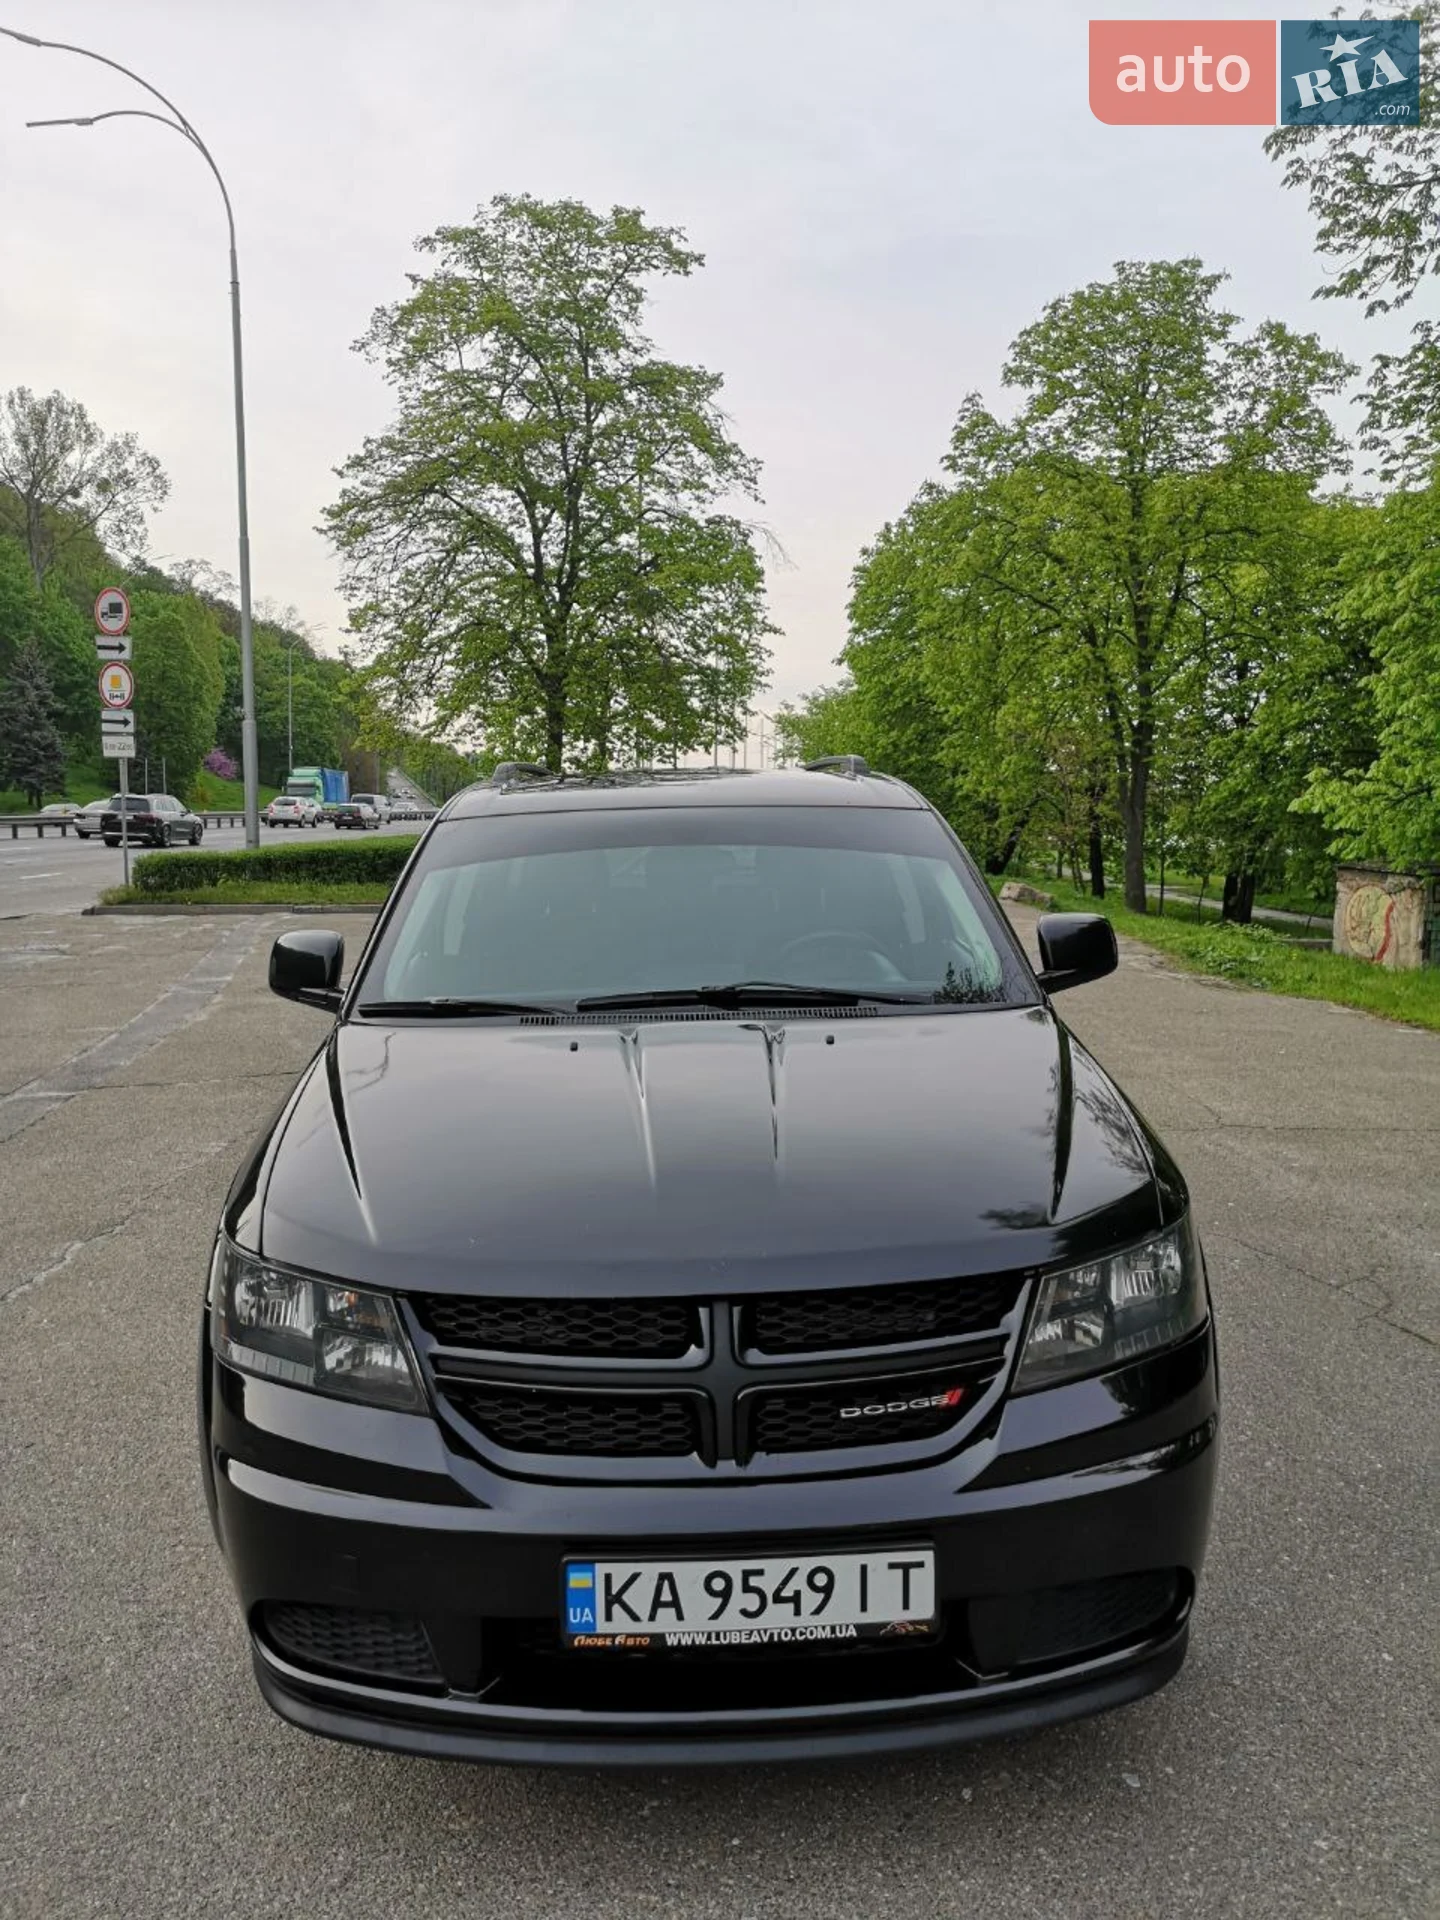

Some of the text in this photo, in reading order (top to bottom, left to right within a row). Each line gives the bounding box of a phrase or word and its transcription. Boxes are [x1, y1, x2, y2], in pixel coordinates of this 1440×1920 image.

[839, 1394, 949, 1418] DODGE
[603, 1571, 685, 1622] KA
[703, 1565, 835, 1621] 9549
[569, 1607, 594, 1624] UA
[665, 1623, 858, 1647] WWW.LUBEAVTO.COM.UA
